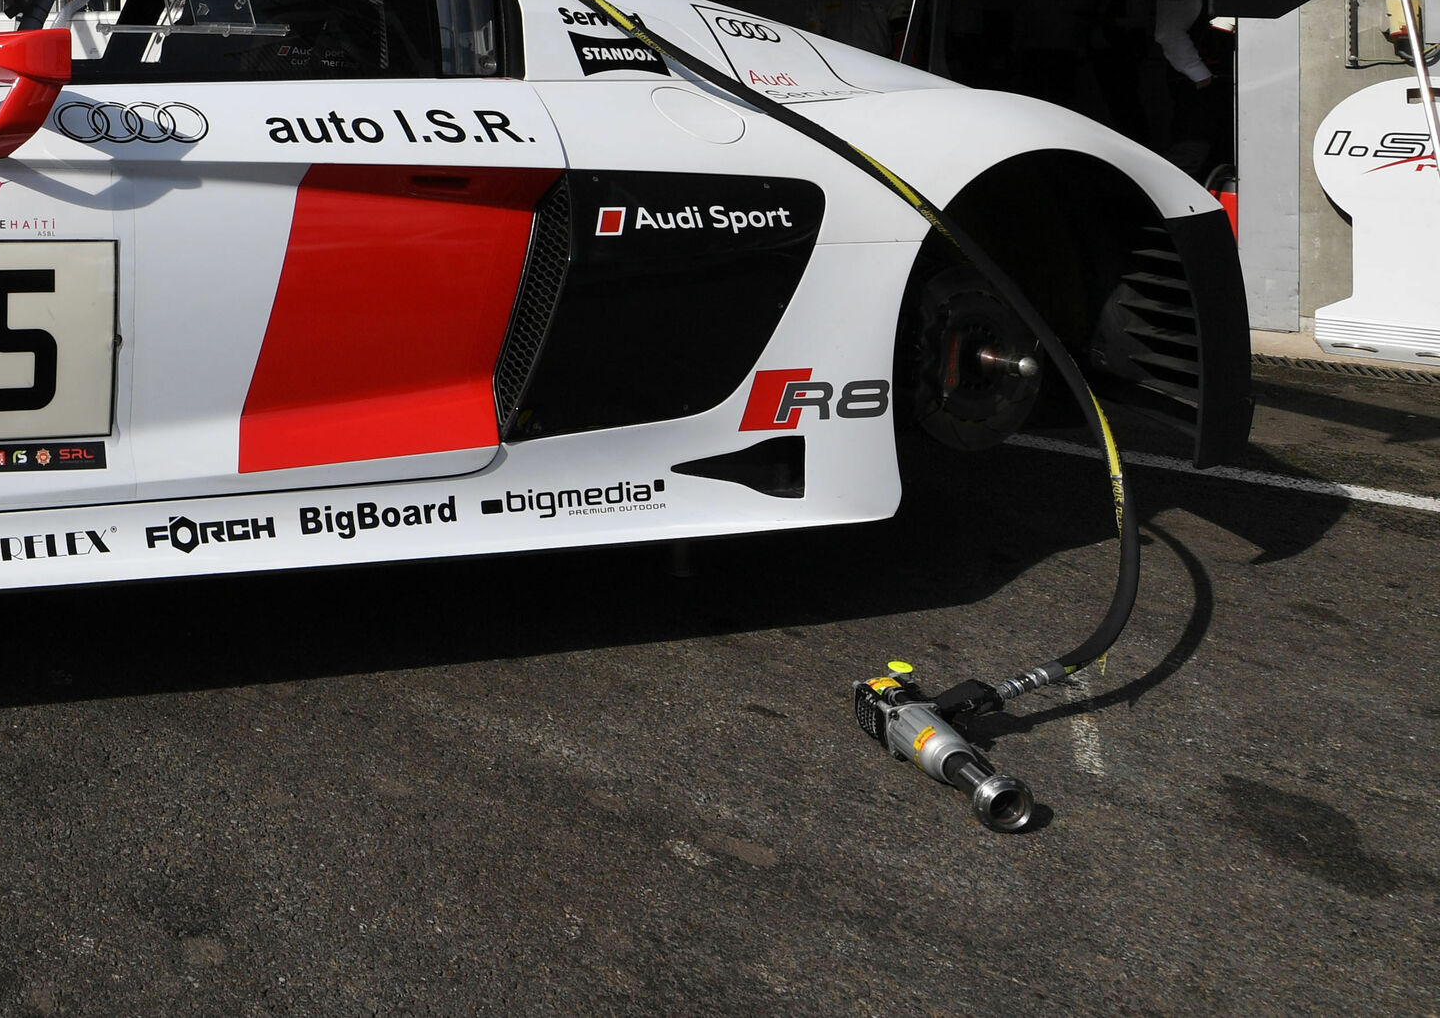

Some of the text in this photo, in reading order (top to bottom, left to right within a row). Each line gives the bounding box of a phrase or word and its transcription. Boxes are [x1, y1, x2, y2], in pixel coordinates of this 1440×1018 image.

[581, 46, 658, 62] STANDOX
[748, 68, 800, 87] Audi
[265, 108, 536, 144] auto I.S.R.
[634, 205, 793, 235] Audi Sport
[768, 375, 890, 423] R8
[299, 495, 458, 540] BigBoard
[506, 480, 653, 519] bigmedia
[567, 502, 667, 517] PREMIUM OUTDOOR
